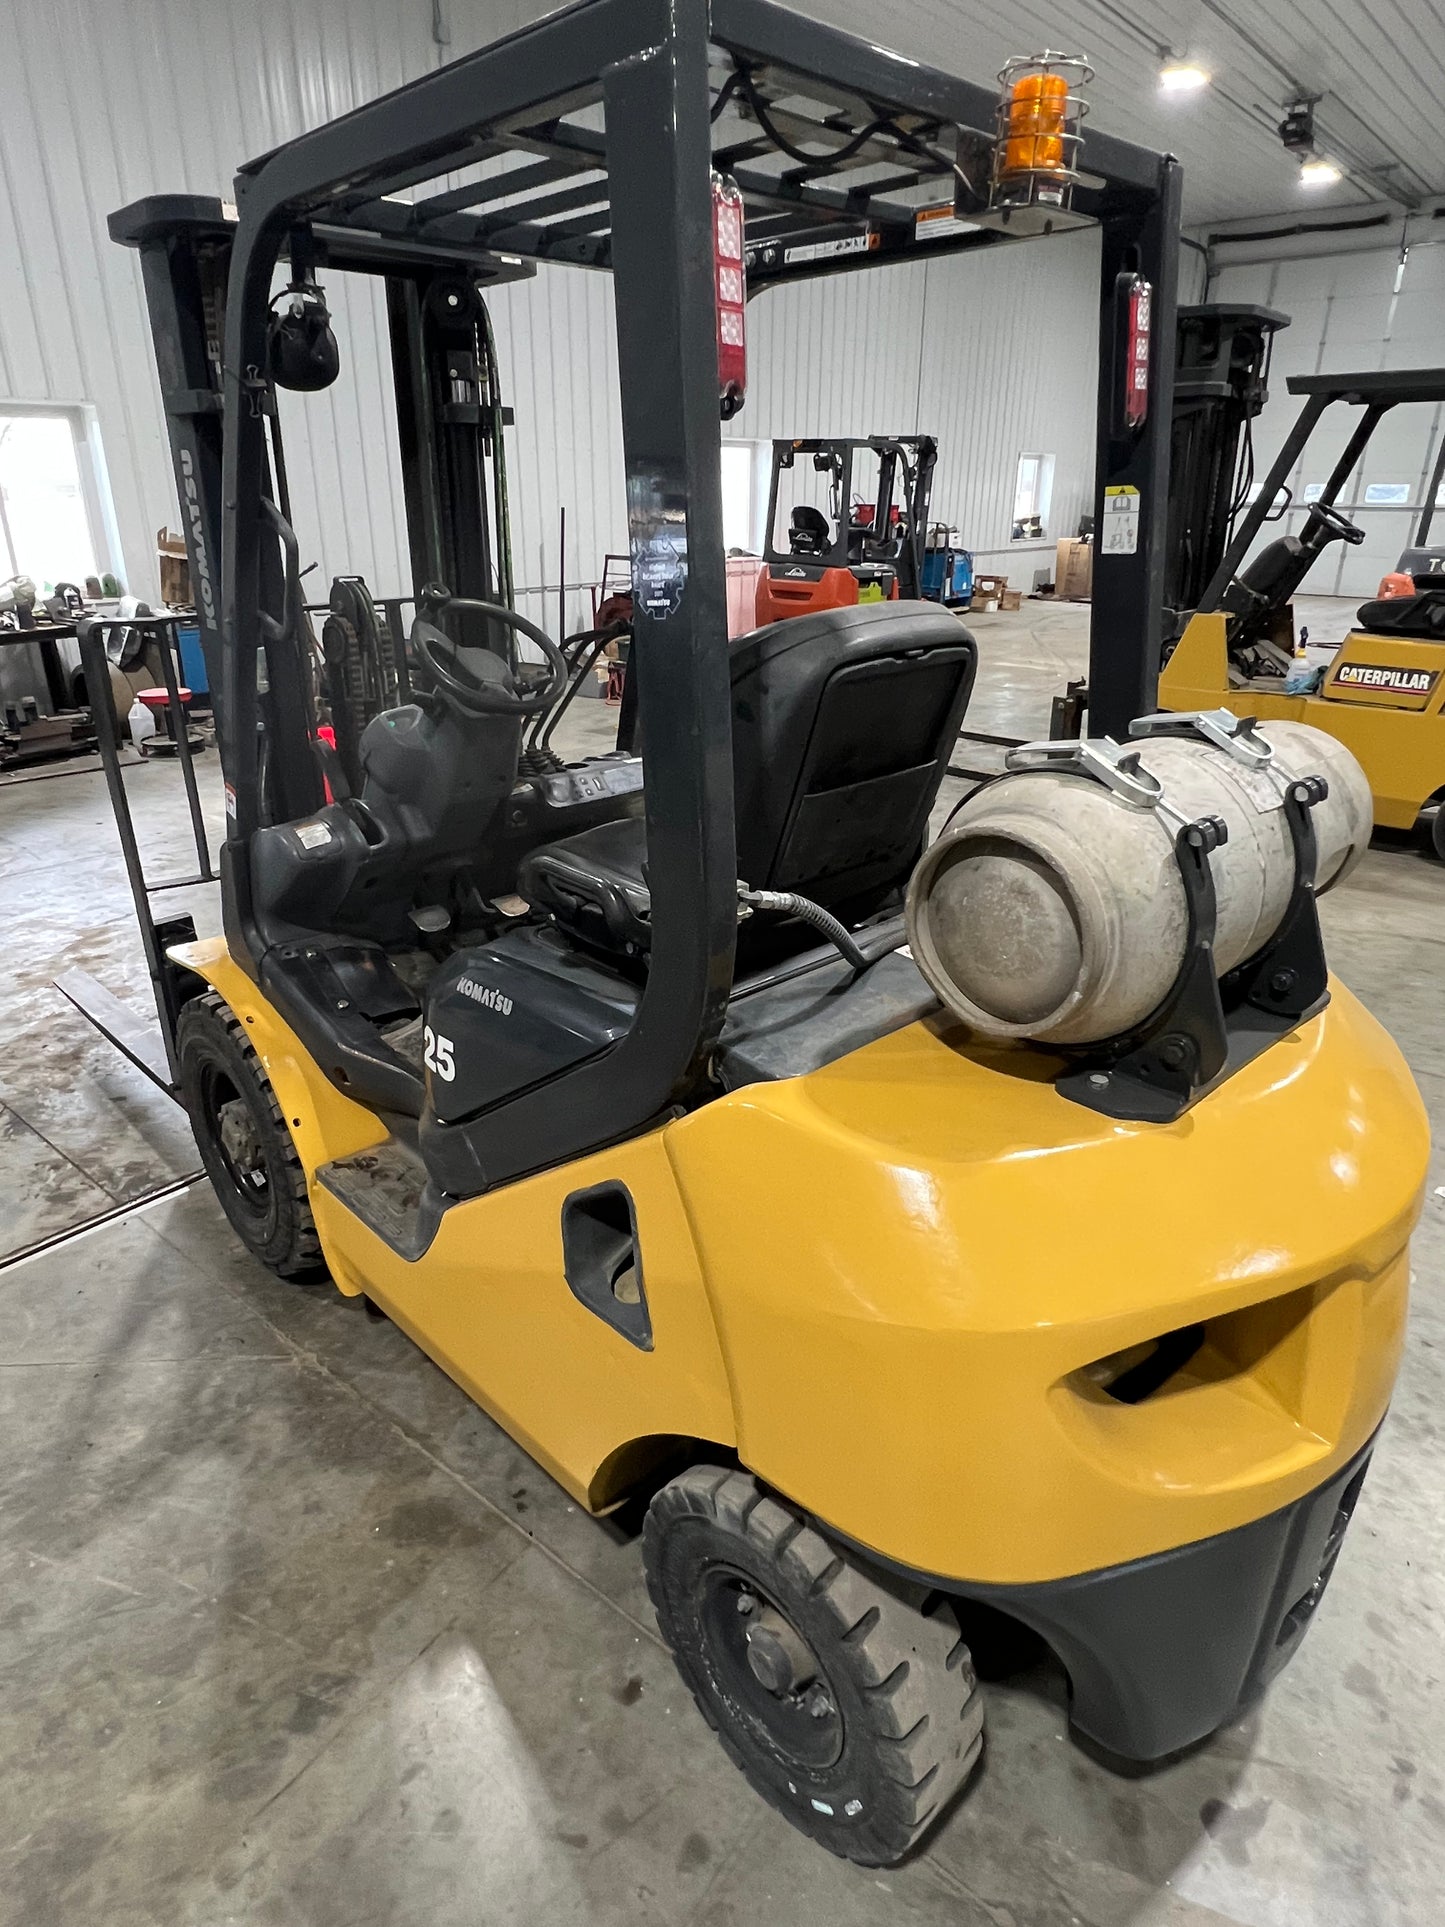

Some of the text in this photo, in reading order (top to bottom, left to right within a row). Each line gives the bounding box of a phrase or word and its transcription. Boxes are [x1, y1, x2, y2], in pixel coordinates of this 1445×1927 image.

[180, 449, 218, 631] KOMATSU
[1339, 666, 1431, 690] CATERPILLAR
[456, 976, 514, 1016] KOMATSU
[424, 1025, 456, 1082] 25
